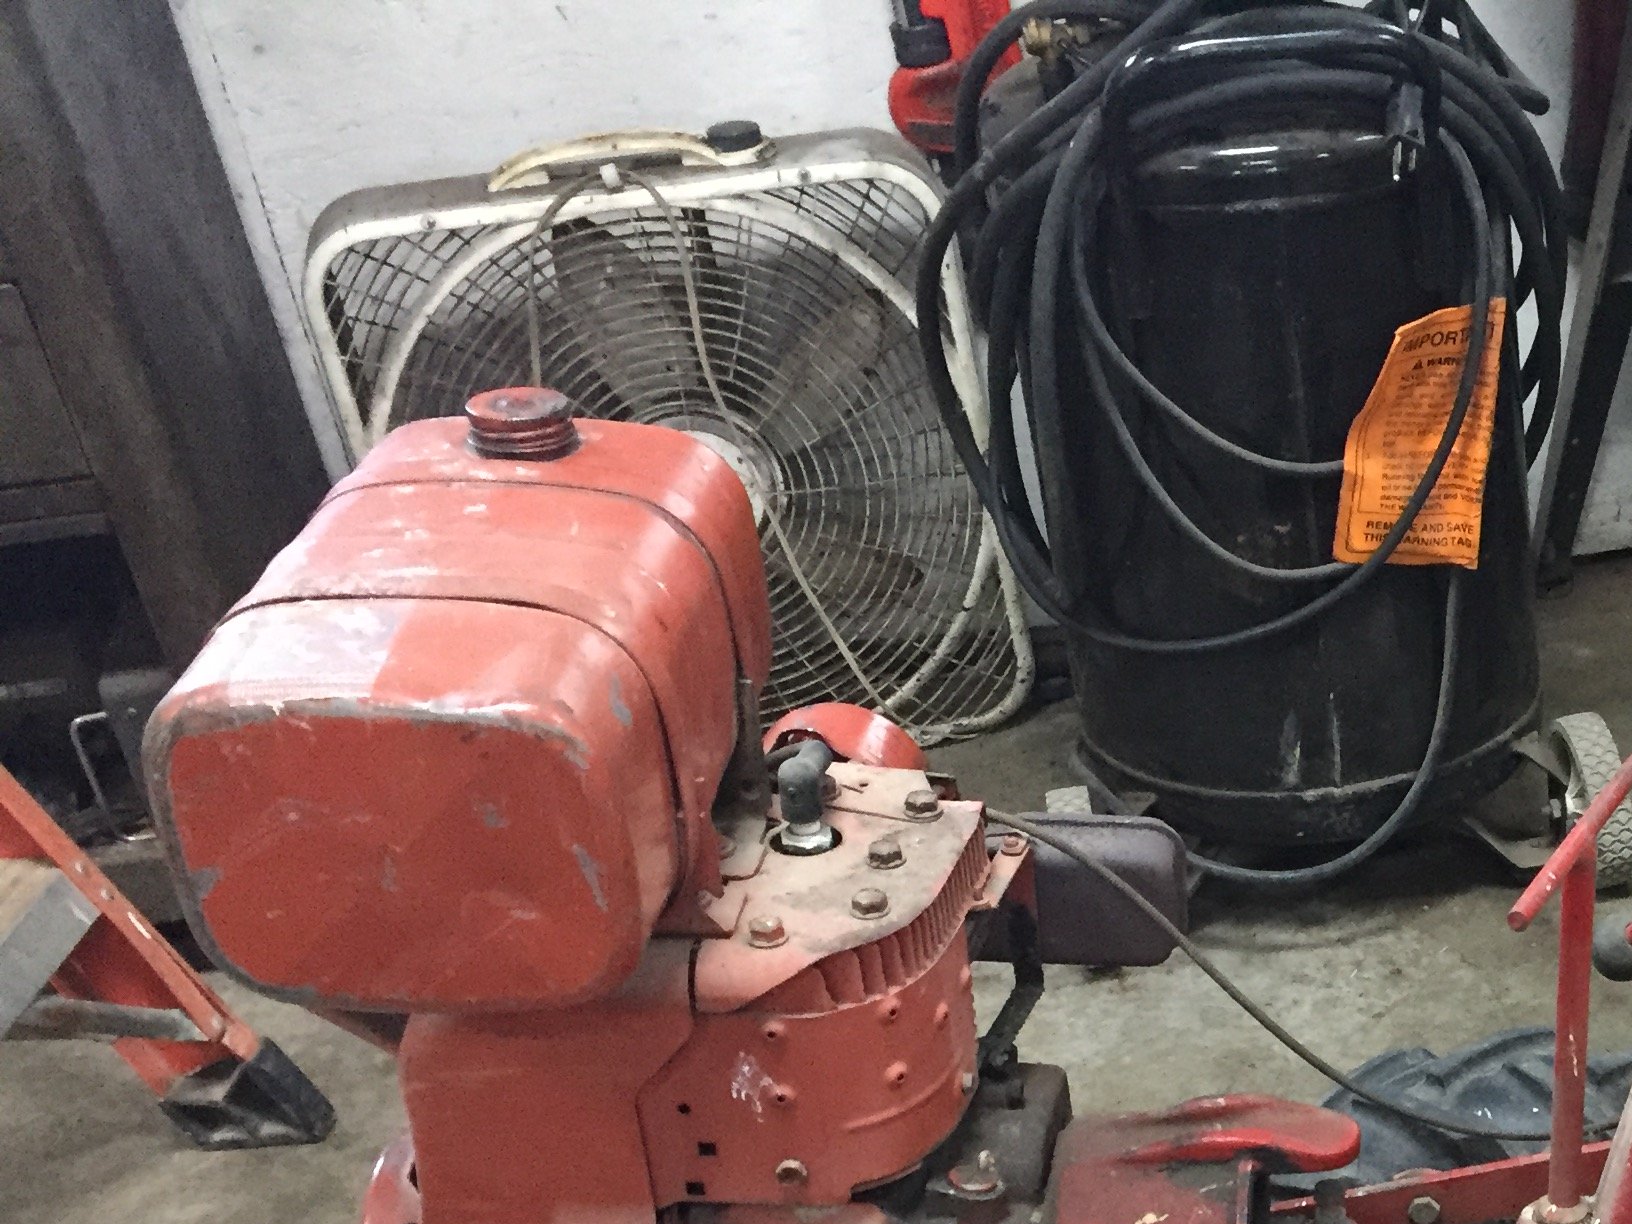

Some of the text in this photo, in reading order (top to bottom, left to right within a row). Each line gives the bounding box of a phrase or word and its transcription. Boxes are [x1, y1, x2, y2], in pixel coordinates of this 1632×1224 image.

[1365, 519, 1475, 534] REME AND SAVE
[1402, 534, 1448, 547] ARNING
